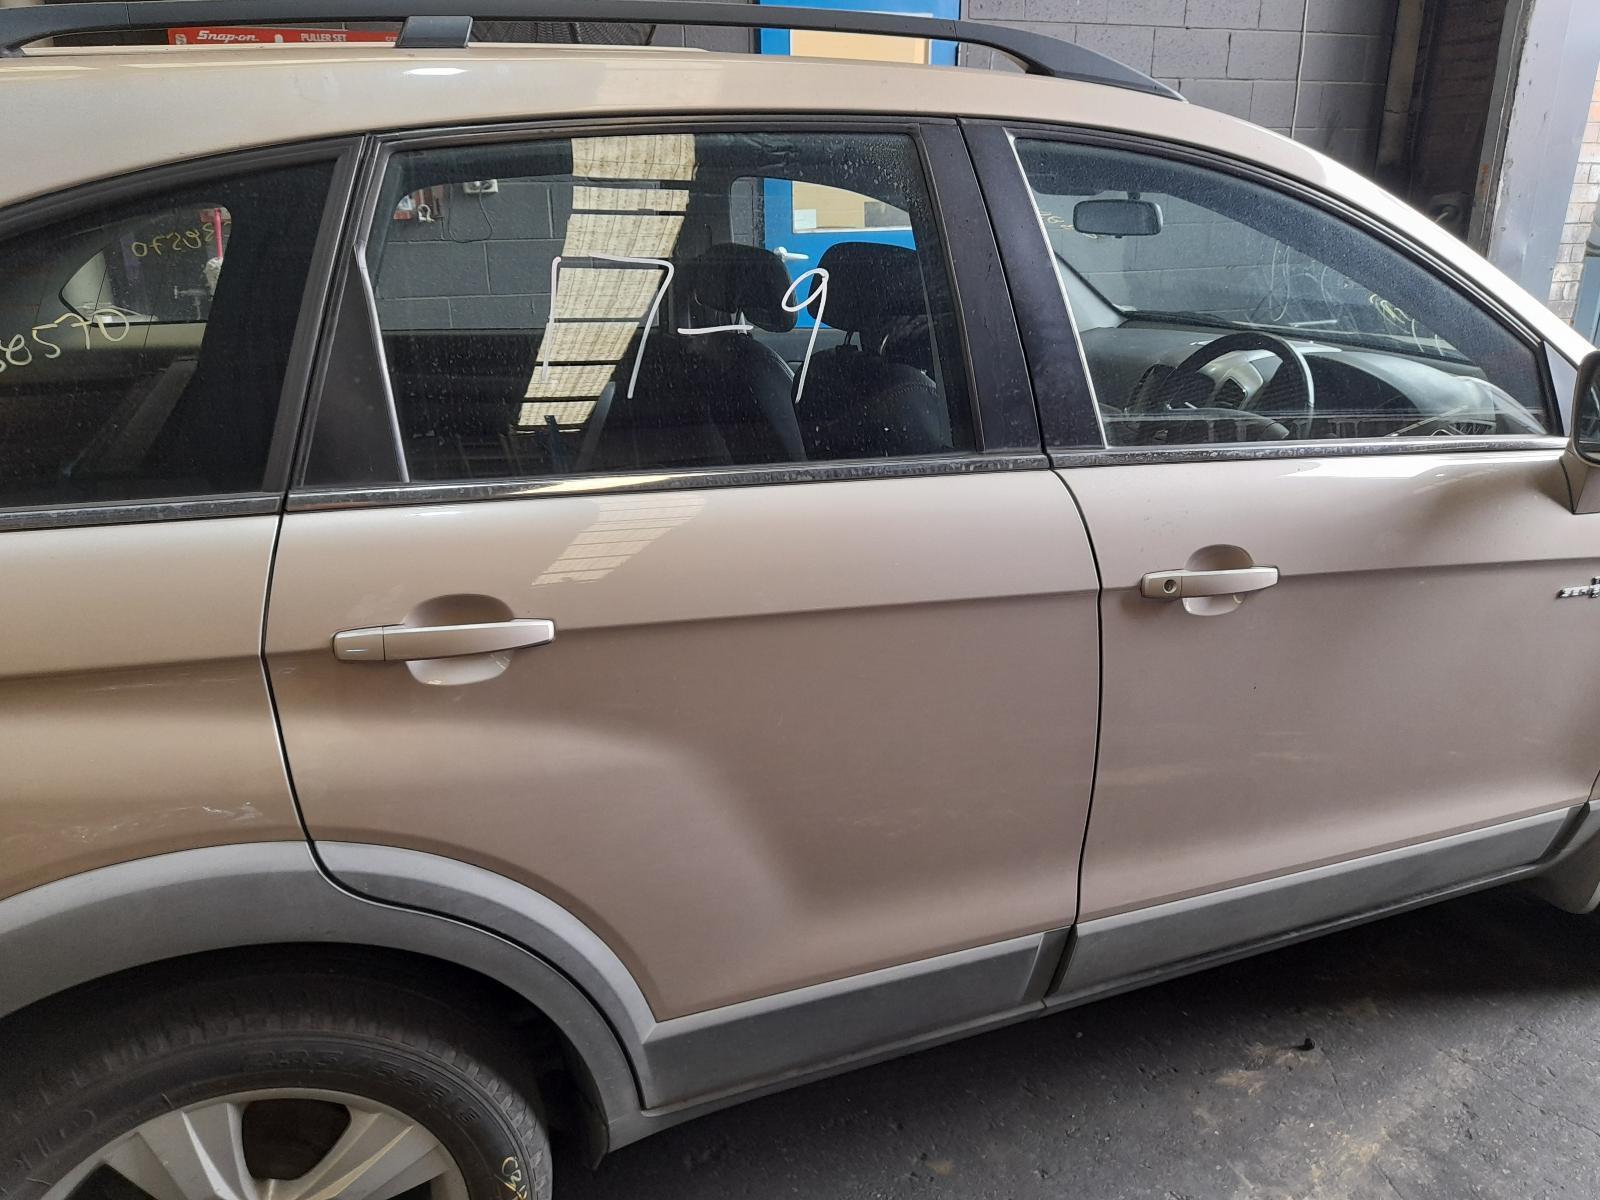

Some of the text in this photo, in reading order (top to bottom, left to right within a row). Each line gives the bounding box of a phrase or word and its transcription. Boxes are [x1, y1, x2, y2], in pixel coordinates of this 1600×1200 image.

[196, 30, 260, 43] Snap-on
[300, 33, 347, 42] PULLER SET
